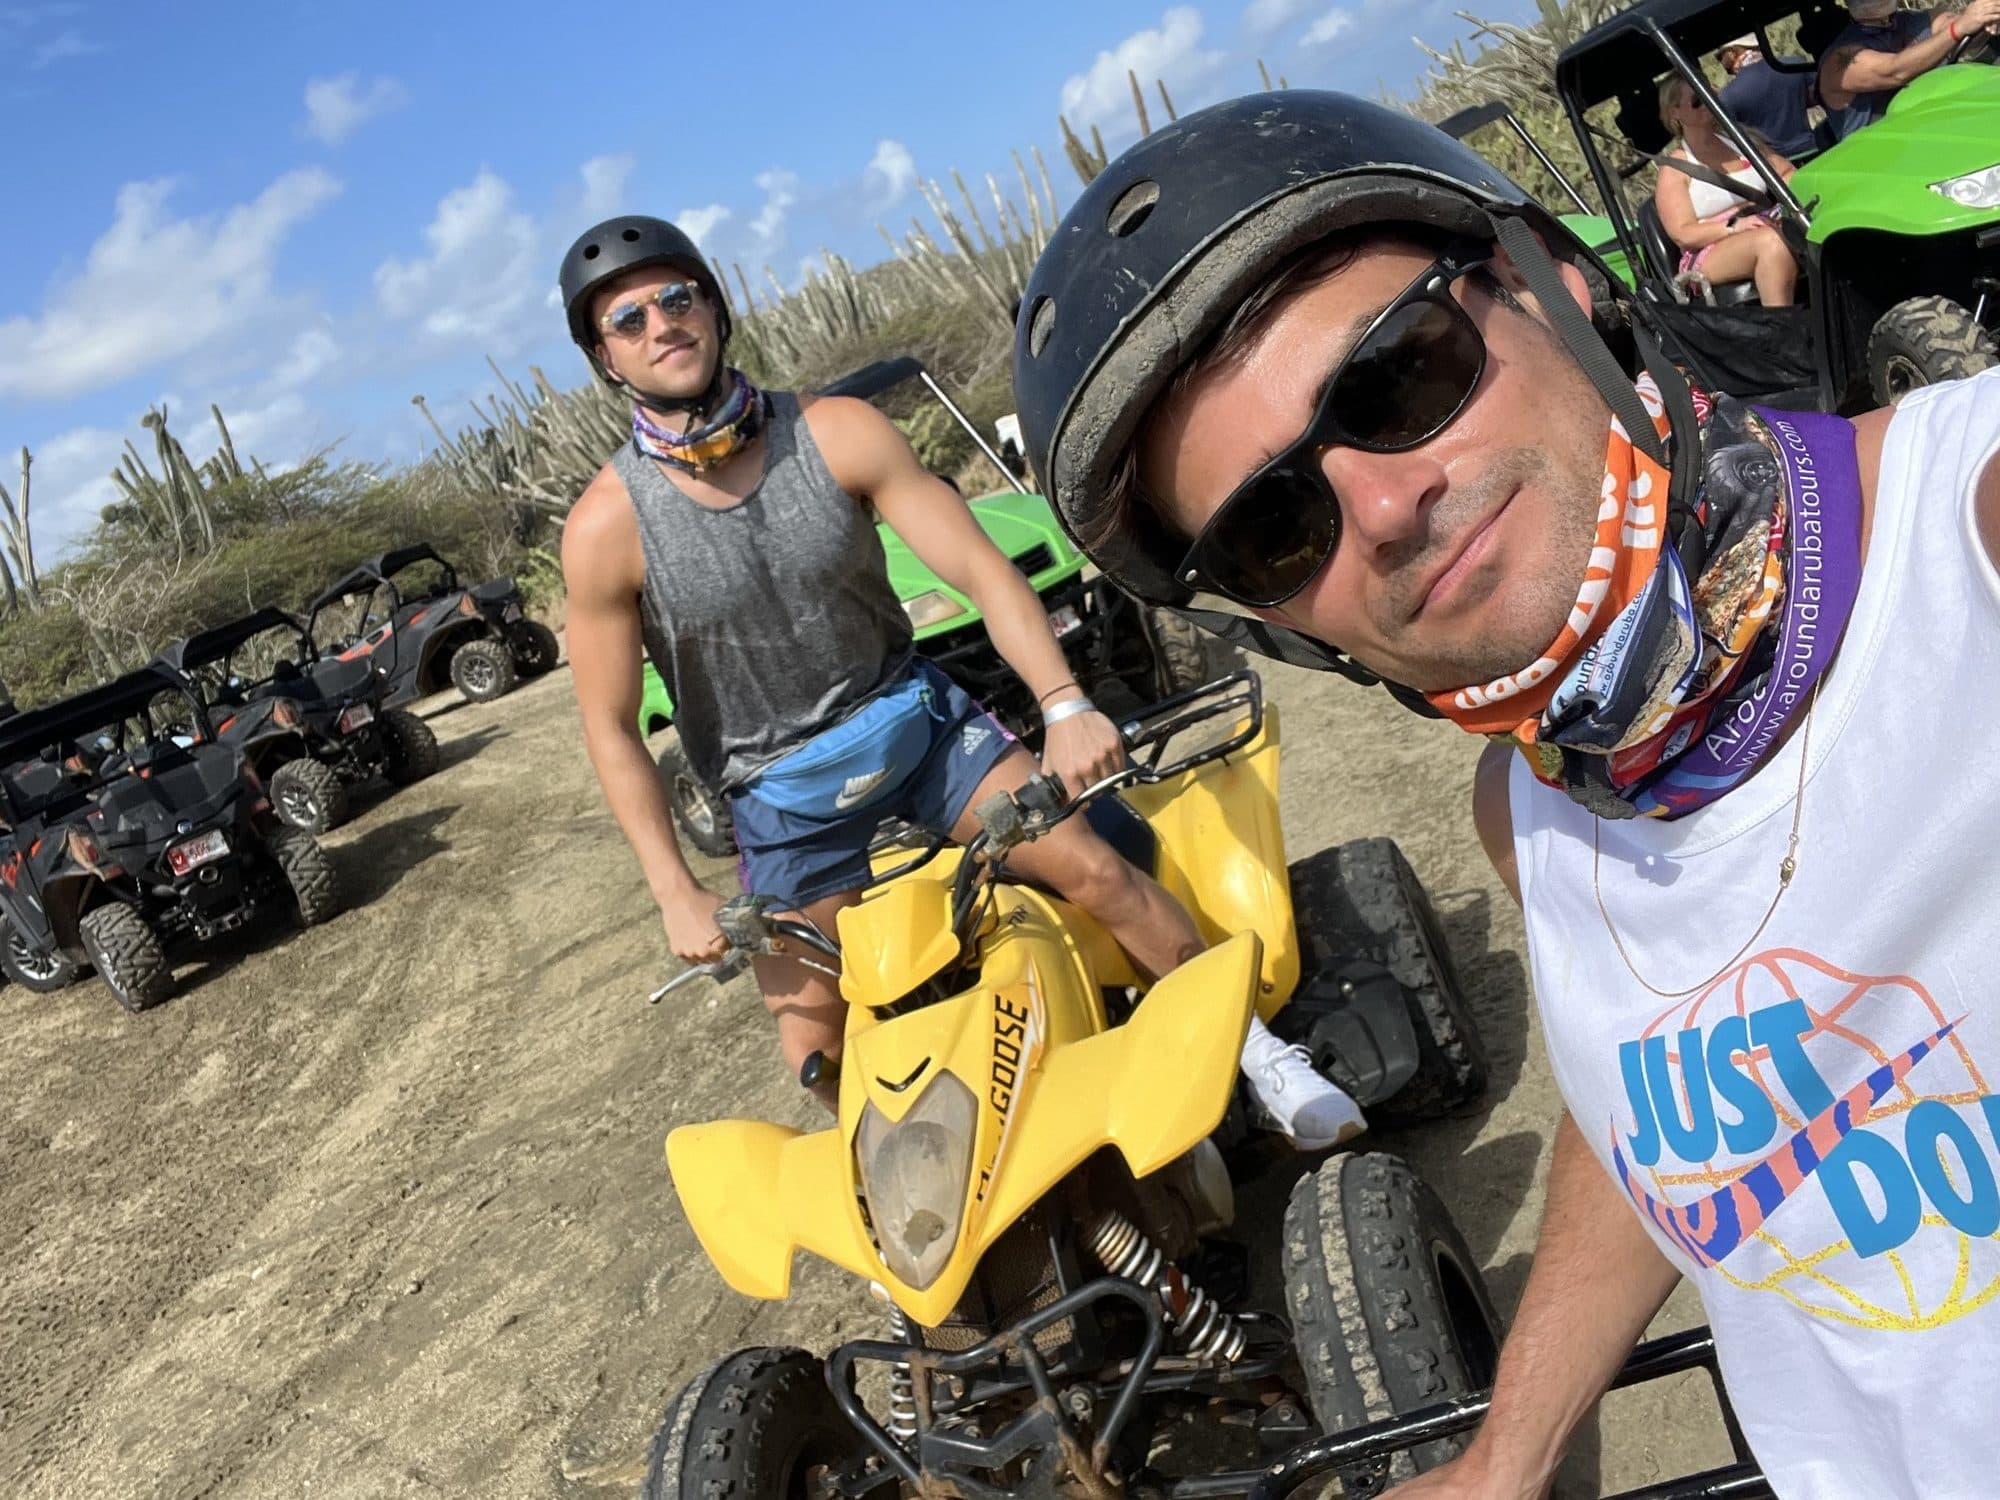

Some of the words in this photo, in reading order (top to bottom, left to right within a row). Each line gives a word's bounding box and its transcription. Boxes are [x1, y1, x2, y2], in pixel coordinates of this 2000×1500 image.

[1736, 420, 1823, 767] www.aroundarubatours.com
[1618, 997, 1837, 1168] JUST
[1815, 1100, 2000, 1260] DO
